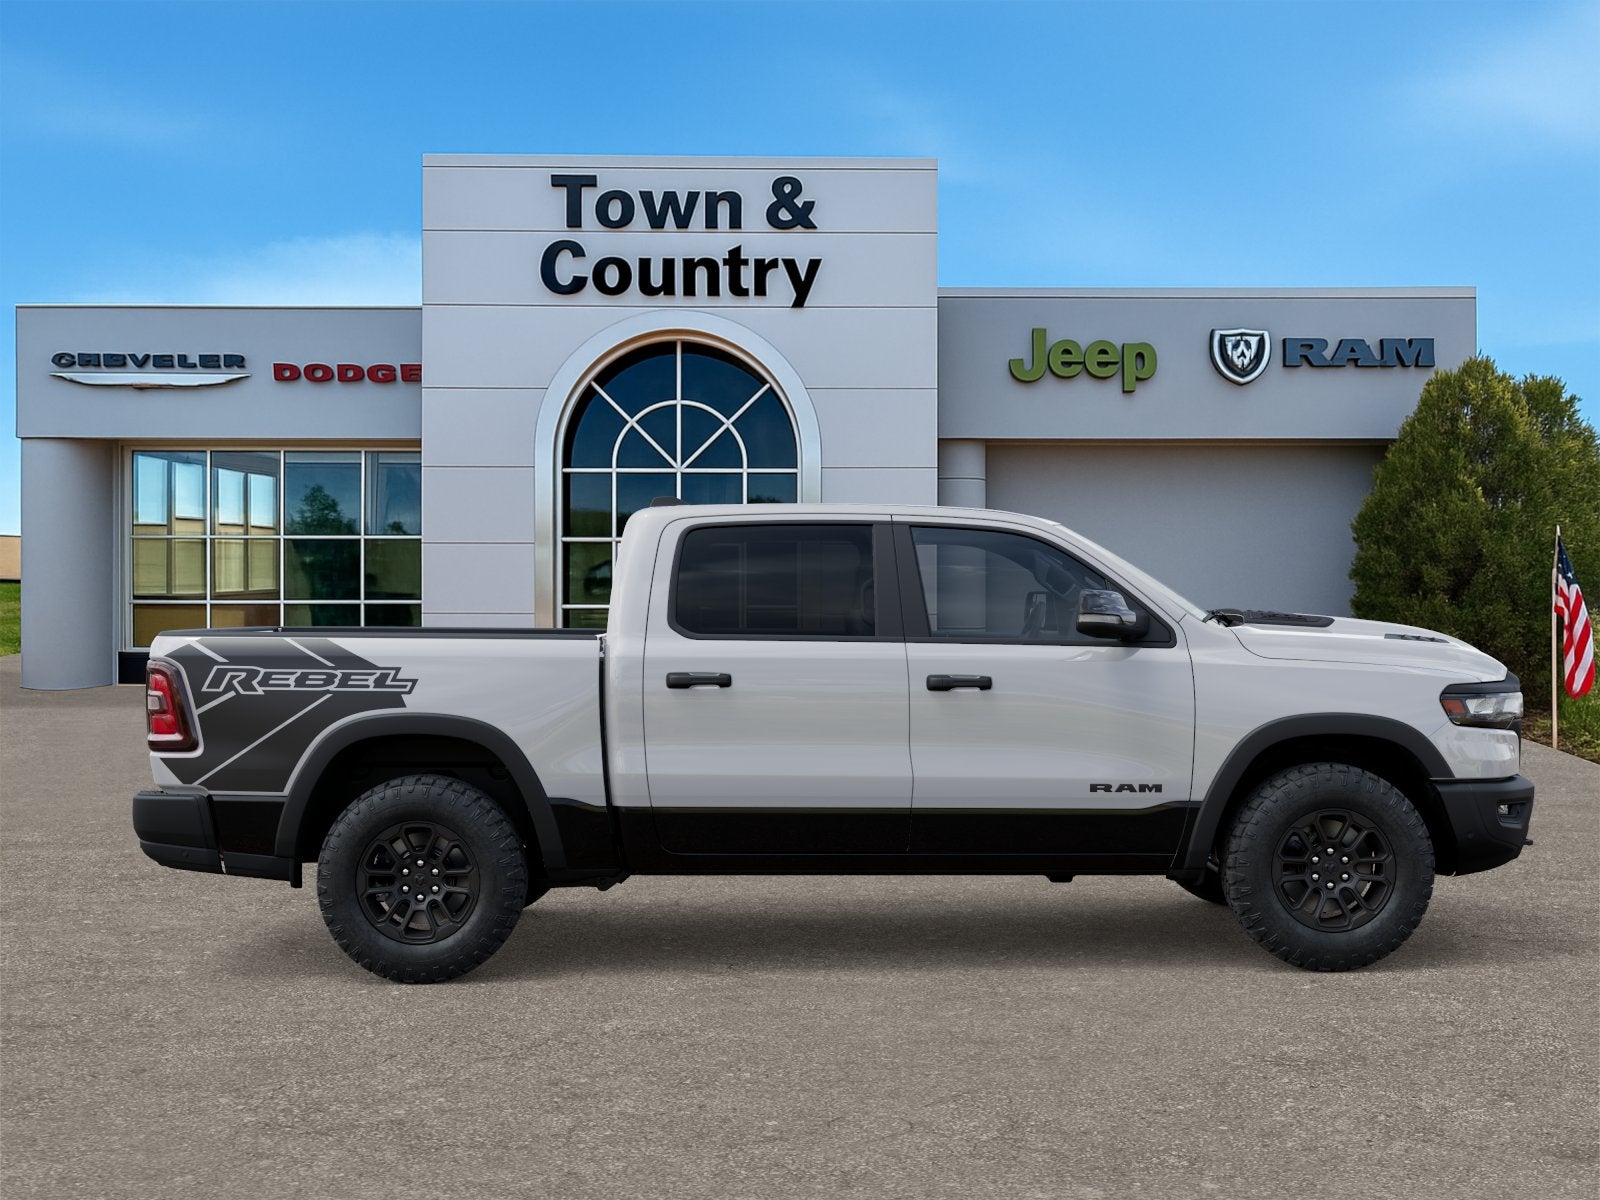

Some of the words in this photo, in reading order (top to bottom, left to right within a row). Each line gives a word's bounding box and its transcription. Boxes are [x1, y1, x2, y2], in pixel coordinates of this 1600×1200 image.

[550, 174, 743, 229] Town
[765, 175, 818, 230] &
[540, 239, 822, 308] Country
[1009, 328, 1157, 393] Jeep
[1282, 337, 1435, 368] RAM
[273, 363, 422, 383] DODGE
[202, 665, 418, 694] REBEL
[1089, 783, 1163, 793] RAM
